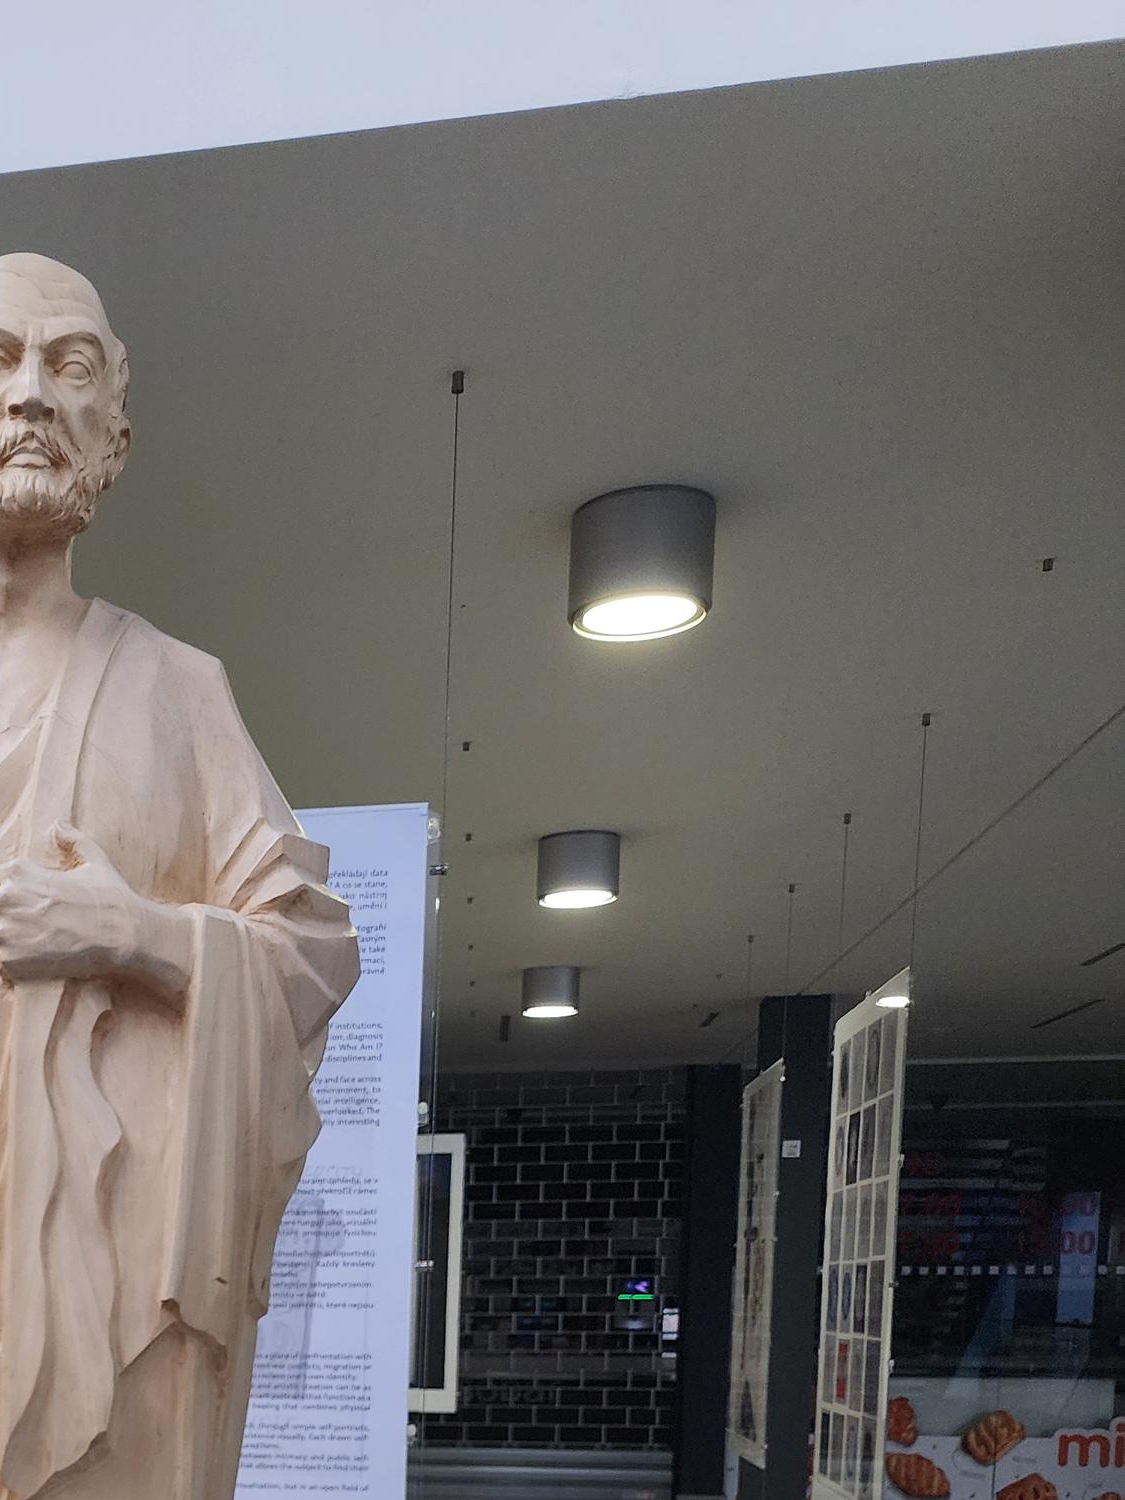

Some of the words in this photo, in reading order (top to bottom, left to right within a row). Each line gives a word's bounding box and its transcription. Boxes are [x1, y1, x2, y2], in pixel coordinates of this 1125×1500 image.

[370, 868, 388, 877] data
[357, 923, 387, 935] tografií
[360, 957, 386, 966] rmací,
[361, 966, 386, 976] rávně
[336, 1021, 384, 1031] institutions,
[346, 1033, 384, 1043] diagnosis
[338, 1043, 358, 1051] Who
[368, 1054, 382, 1062] and
